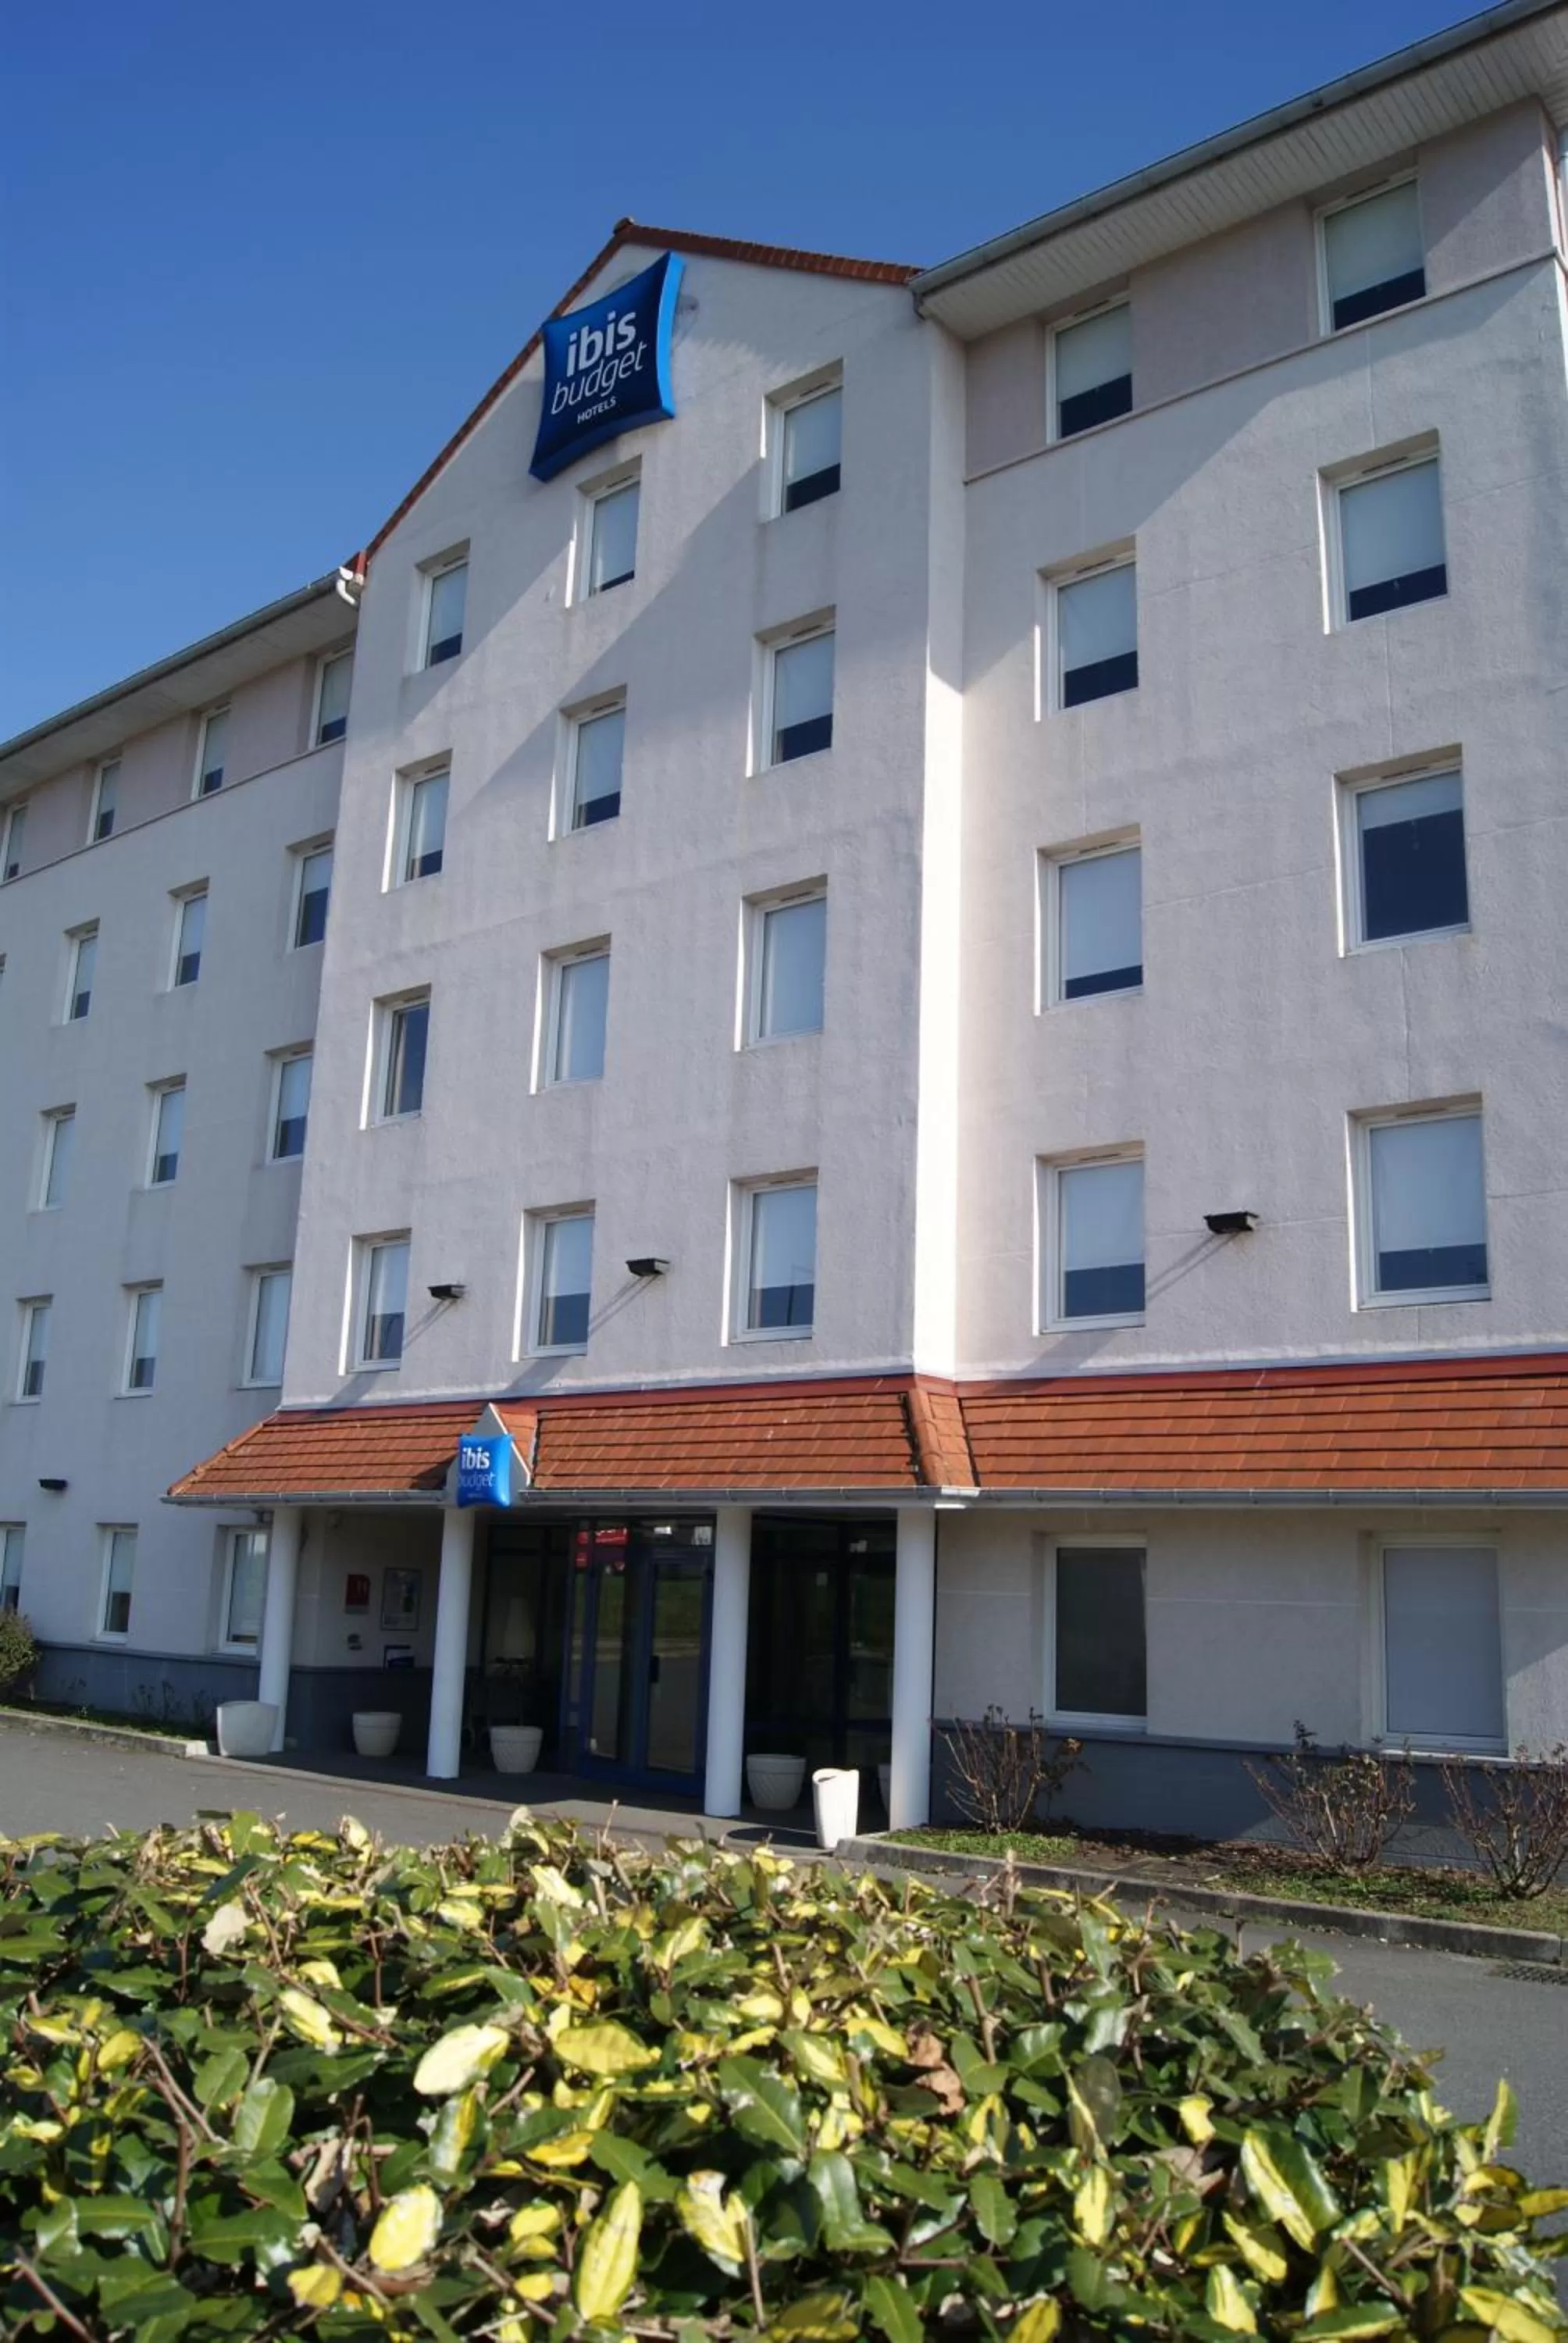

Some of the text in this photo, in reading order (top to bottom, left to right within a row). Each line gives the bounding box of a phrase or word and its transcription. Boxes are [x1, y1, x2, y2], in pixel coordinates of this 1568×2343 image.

[566, 311, 636, 378] ibis
[551, 341, 647, 415] budget
[577, 396, 617, 424] HOTELS
[461, 1446, 490, 1469] ibis
[458, 1471, 495, 1490] budget
